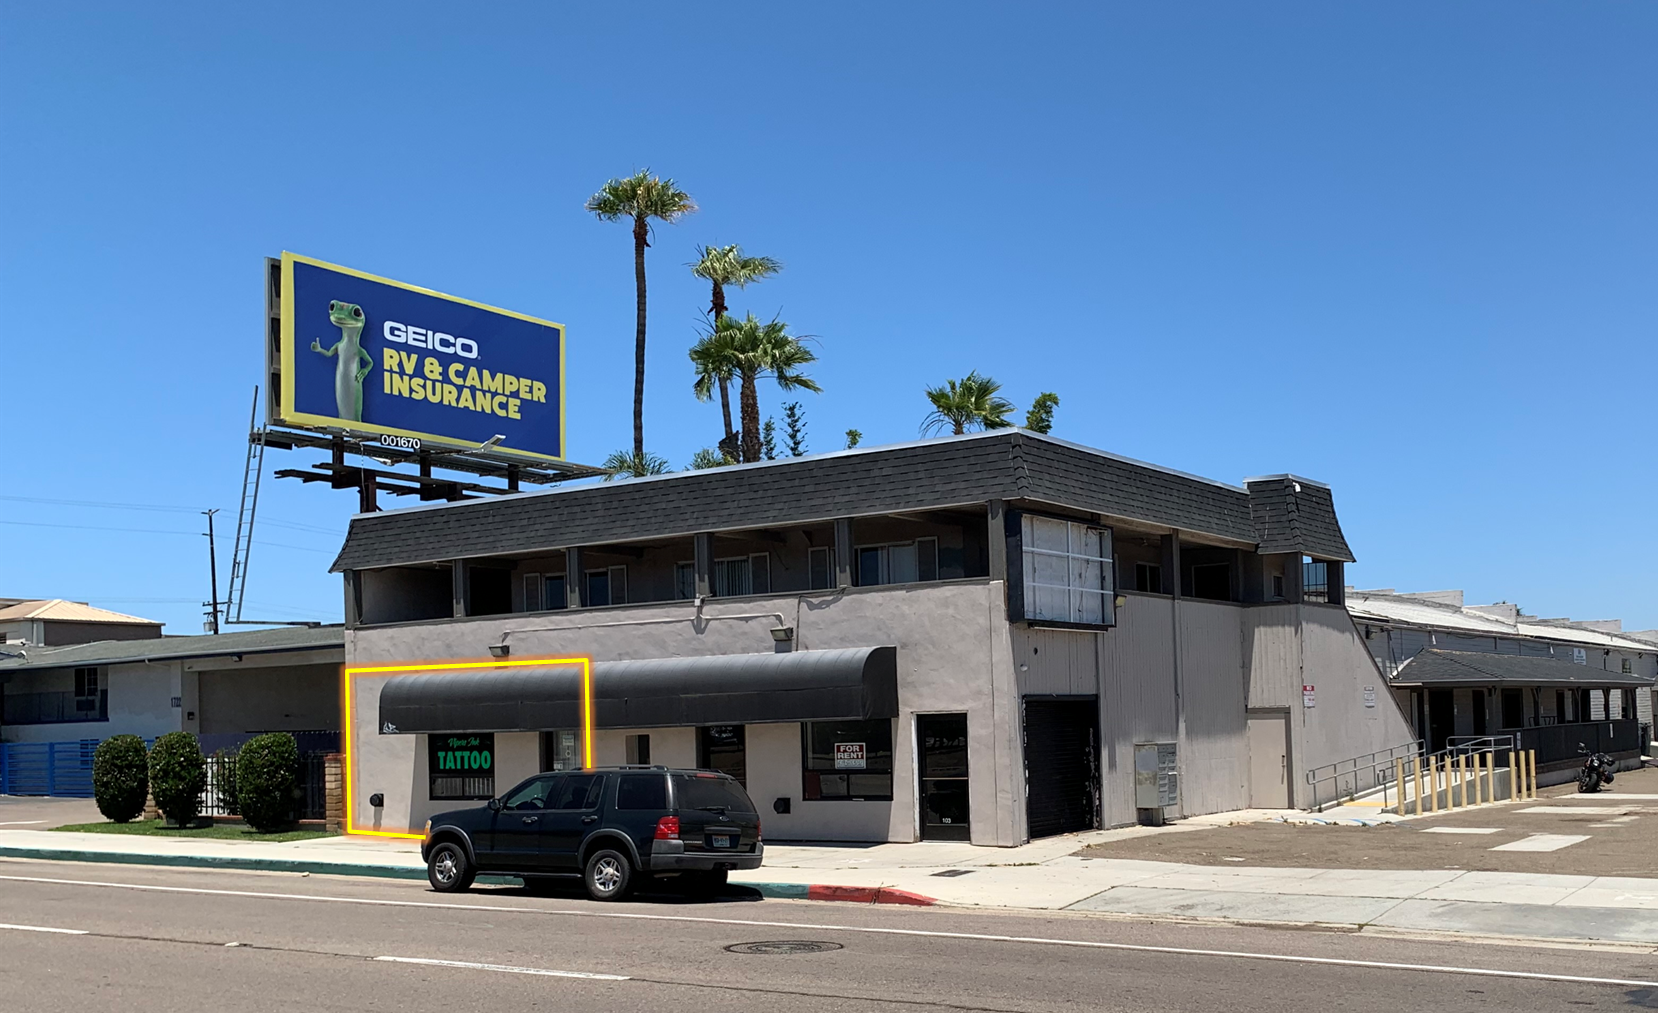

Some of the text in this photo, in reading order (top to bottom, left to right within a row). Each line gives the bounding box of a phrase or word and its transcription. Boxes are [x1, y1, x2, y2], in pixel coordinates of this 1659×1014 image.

[383, 320, 479, 359] GEICO
[383, 347, 547, 403] RV & CAMPER
[383, 371, 522, 420] INSURANCE
[381, 434, 421, 449] 001670
[437, 750, 492, 770] TATTOO
